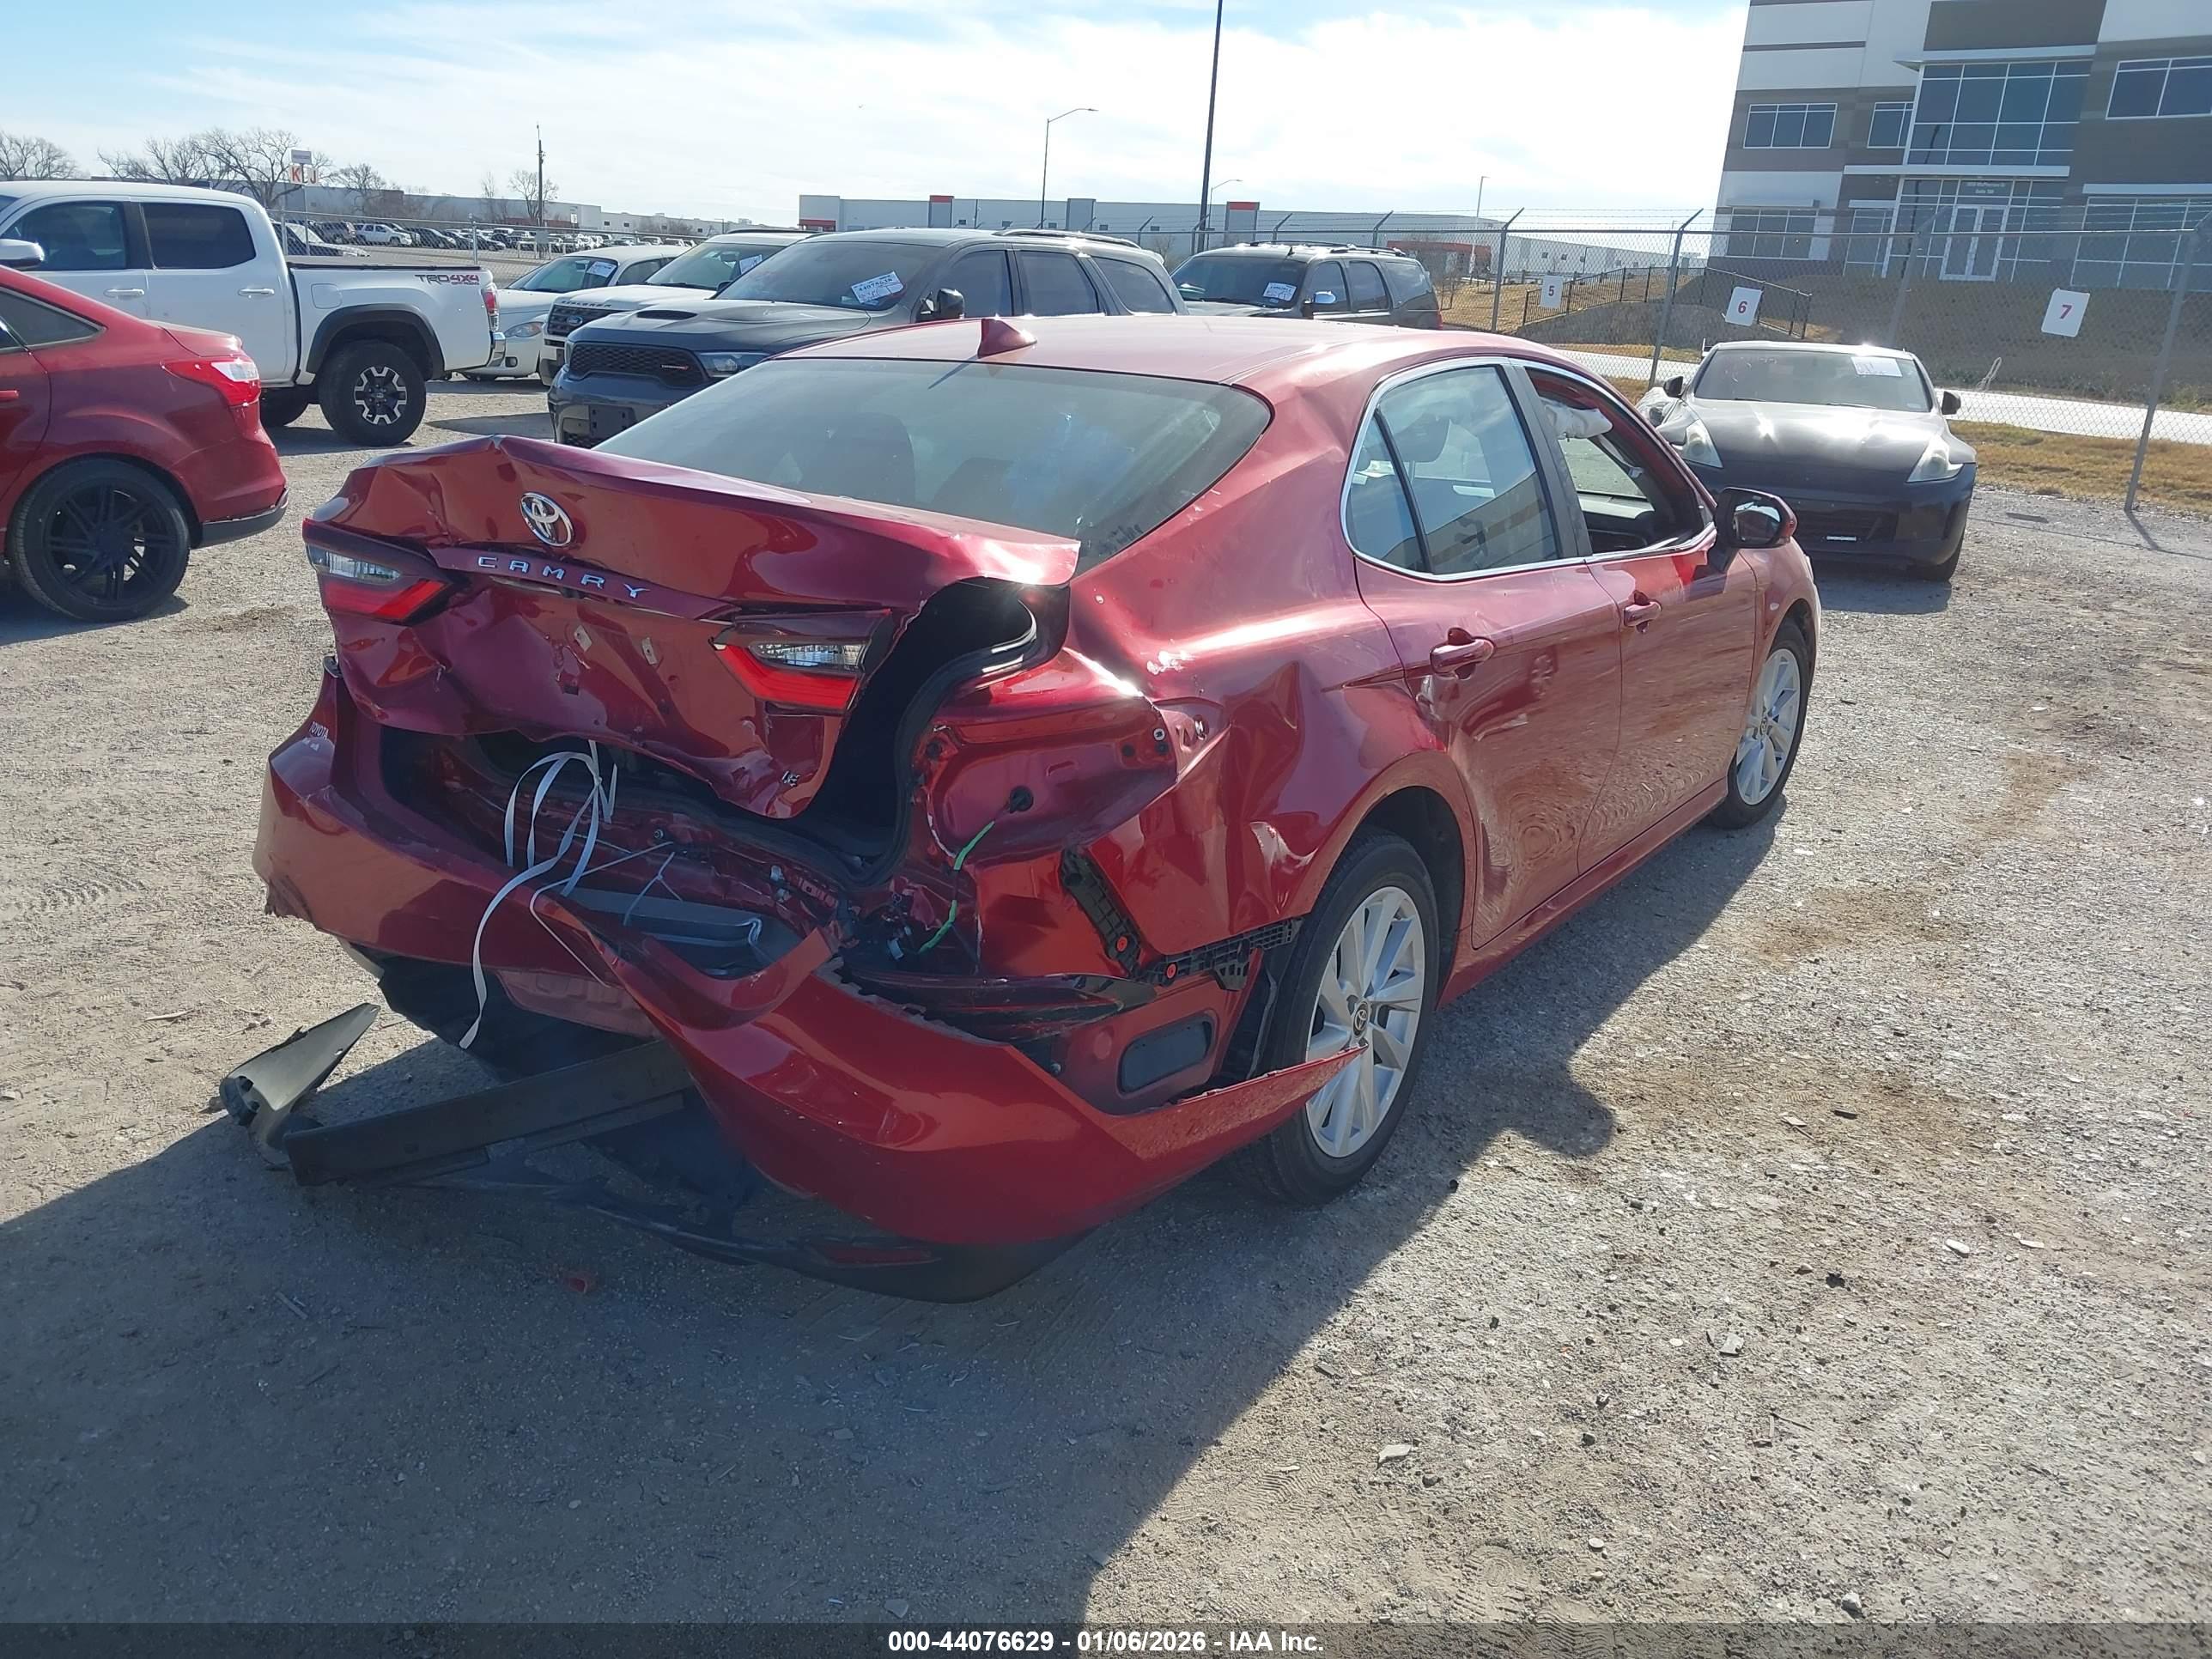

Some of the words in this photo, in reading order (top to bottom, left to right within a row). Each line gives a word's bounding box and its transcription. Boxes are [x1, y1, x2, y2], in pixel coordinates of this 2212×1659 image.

[292, 167, 301, 182] K
[310, 170, 317, 184] J
[1548, 285, 1555, 296] 5
[1738, 301, 1747, 313] 6
[2060, 304, 2073, 319] 7
[477, 556, 650, 599] CAMRY
